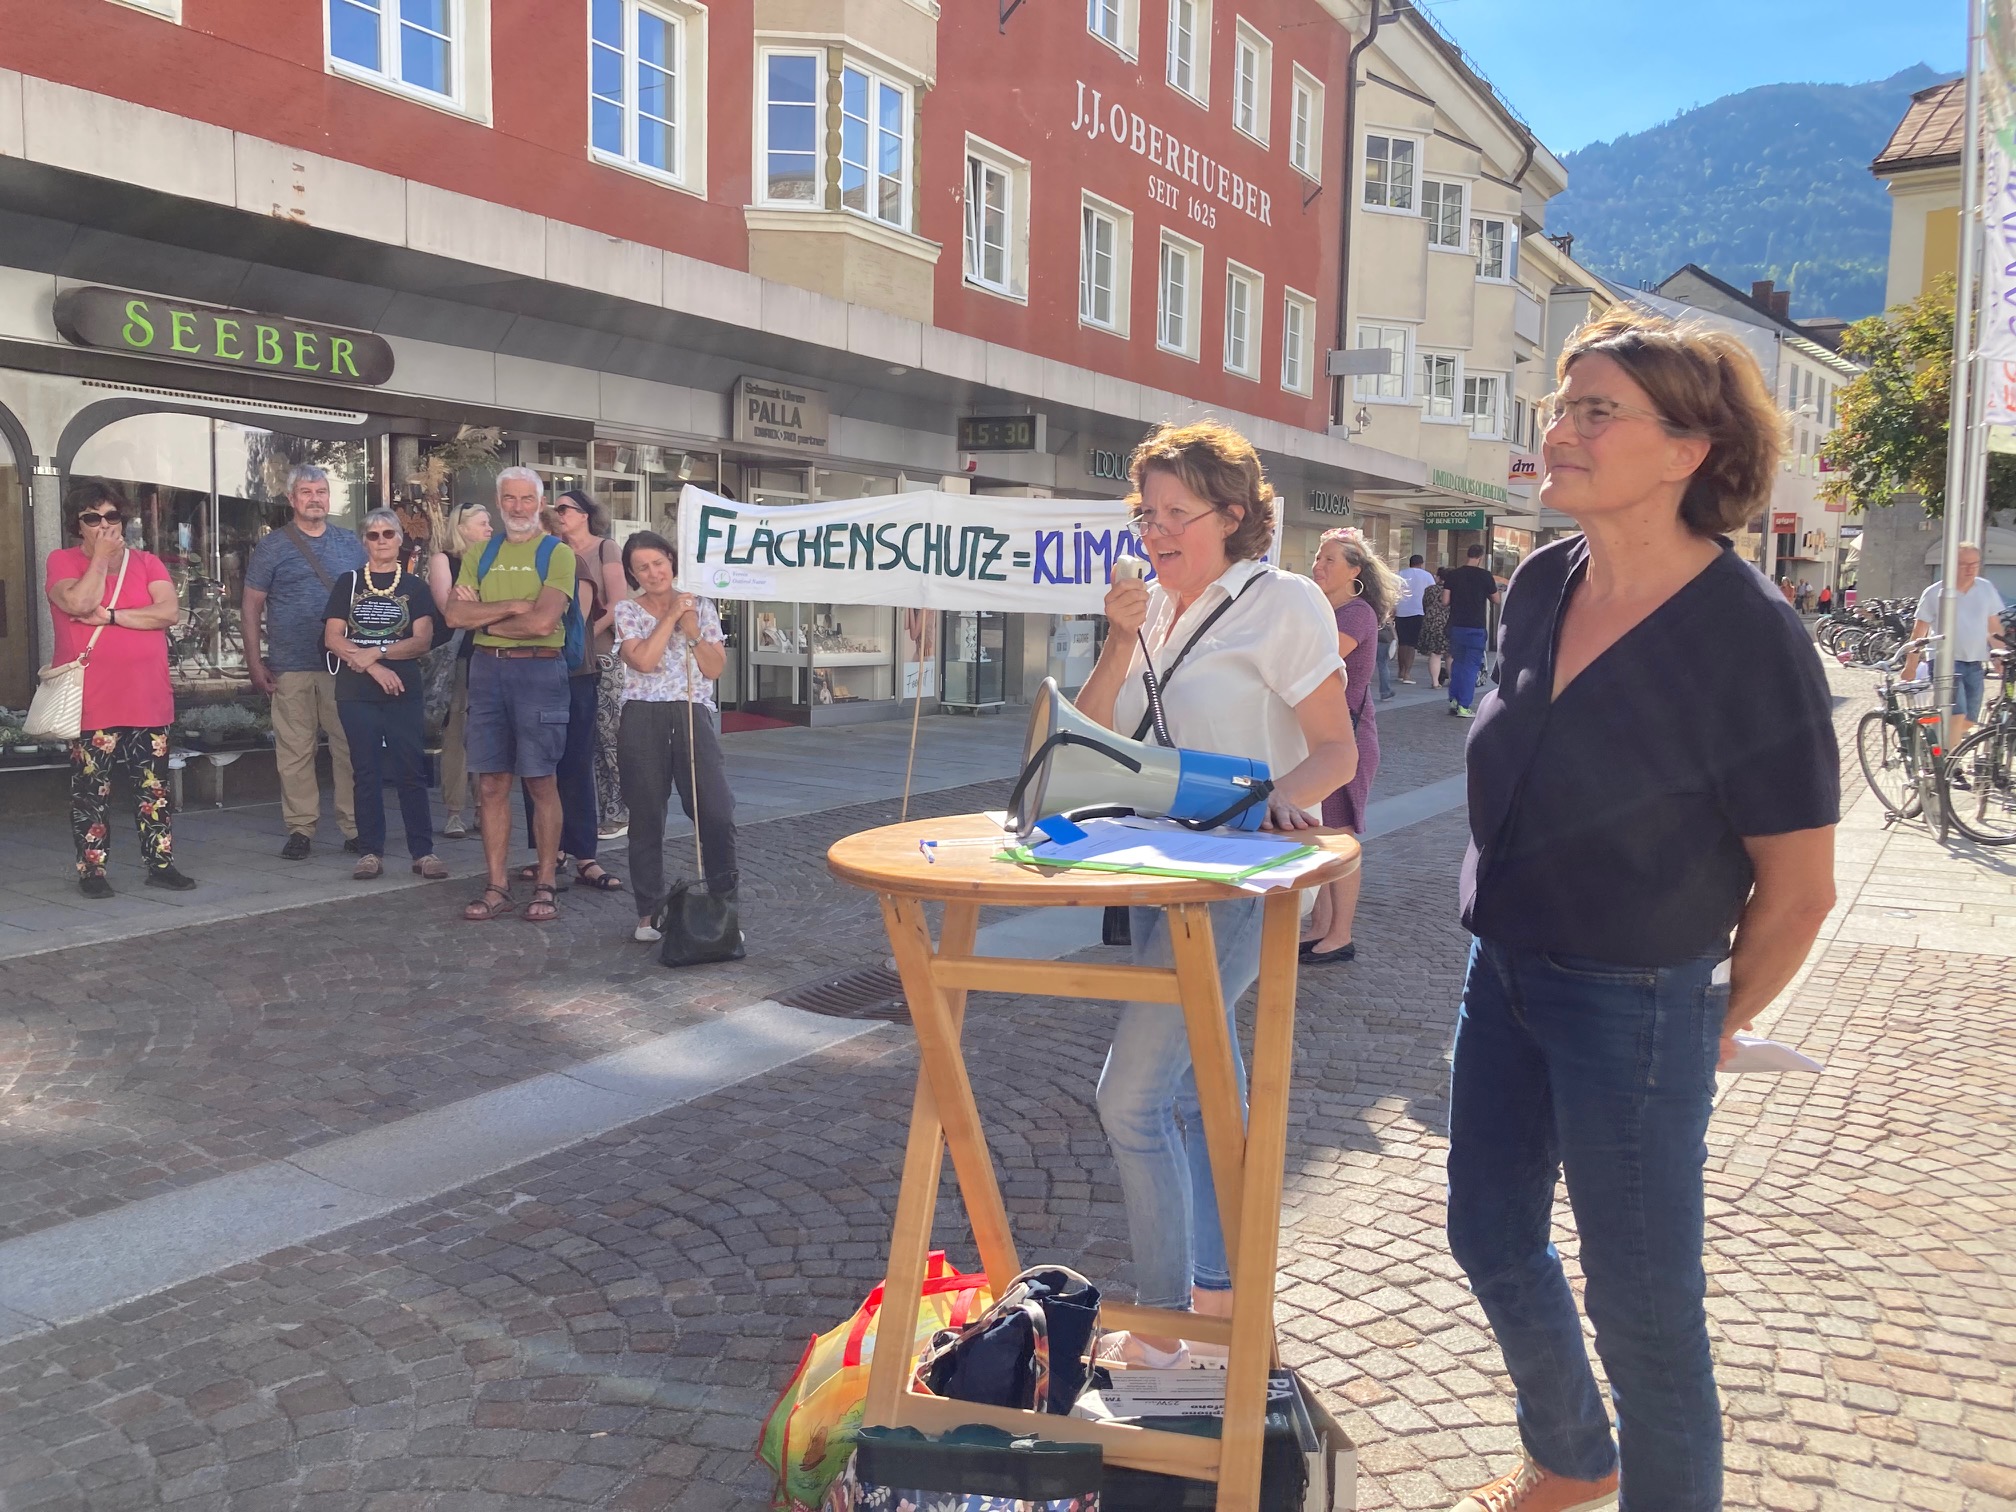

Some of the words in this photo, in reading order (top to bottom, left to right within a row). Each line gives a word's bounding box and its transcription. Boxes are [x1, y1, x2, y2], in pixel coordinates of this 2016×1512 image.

[1109, 103, 1272, 227] OBERHUEBER
[1147, 174, 1180, 211] SEIT
[1187, 196, 1216, 230] 1625
[122, 300, 360, 377] SEEBER
[748, 398, 802, 429] PALLA
[1512, 459, 1535, 473] dm
[1315, 490, 1350, 516] DOUGLAS
